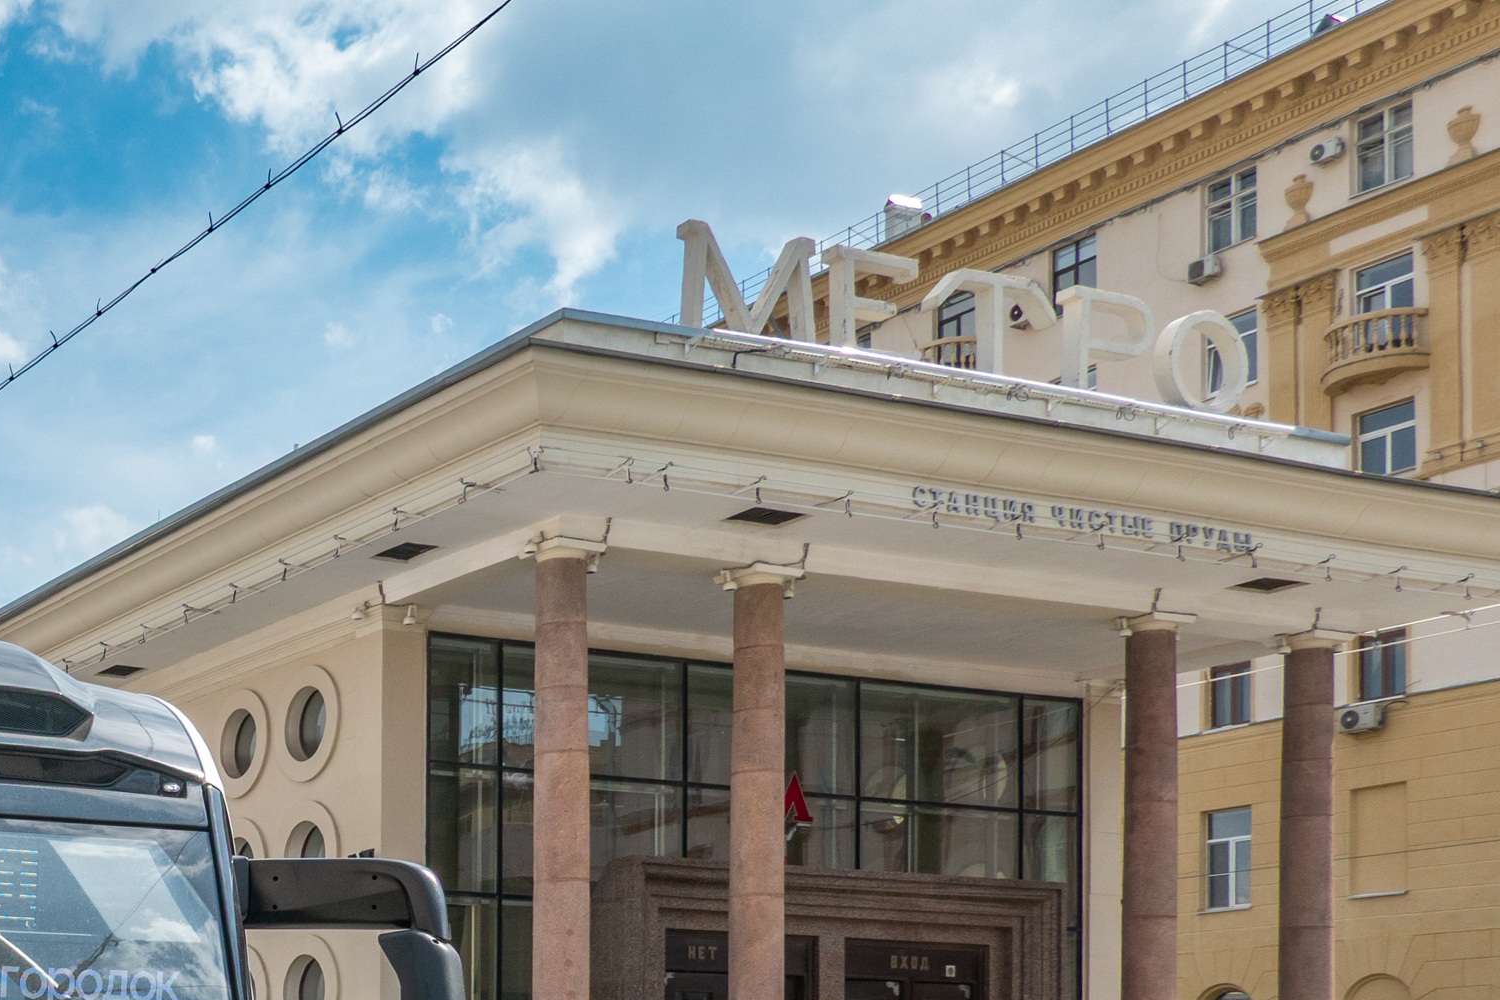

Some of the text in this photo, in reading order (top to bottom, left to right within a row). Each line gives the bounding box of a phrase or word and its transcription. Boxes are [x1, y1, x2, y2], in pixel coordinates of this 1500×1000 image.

[676, 218, 1250, 414] МЕТРО
[912, 486, 1253, 552] СТАНЦИЯ ЧИСТЫЕ ПРУДЫ
[687, 945, 718, 961] НЕТ
[890, 955, 930, 971] ВХОД
